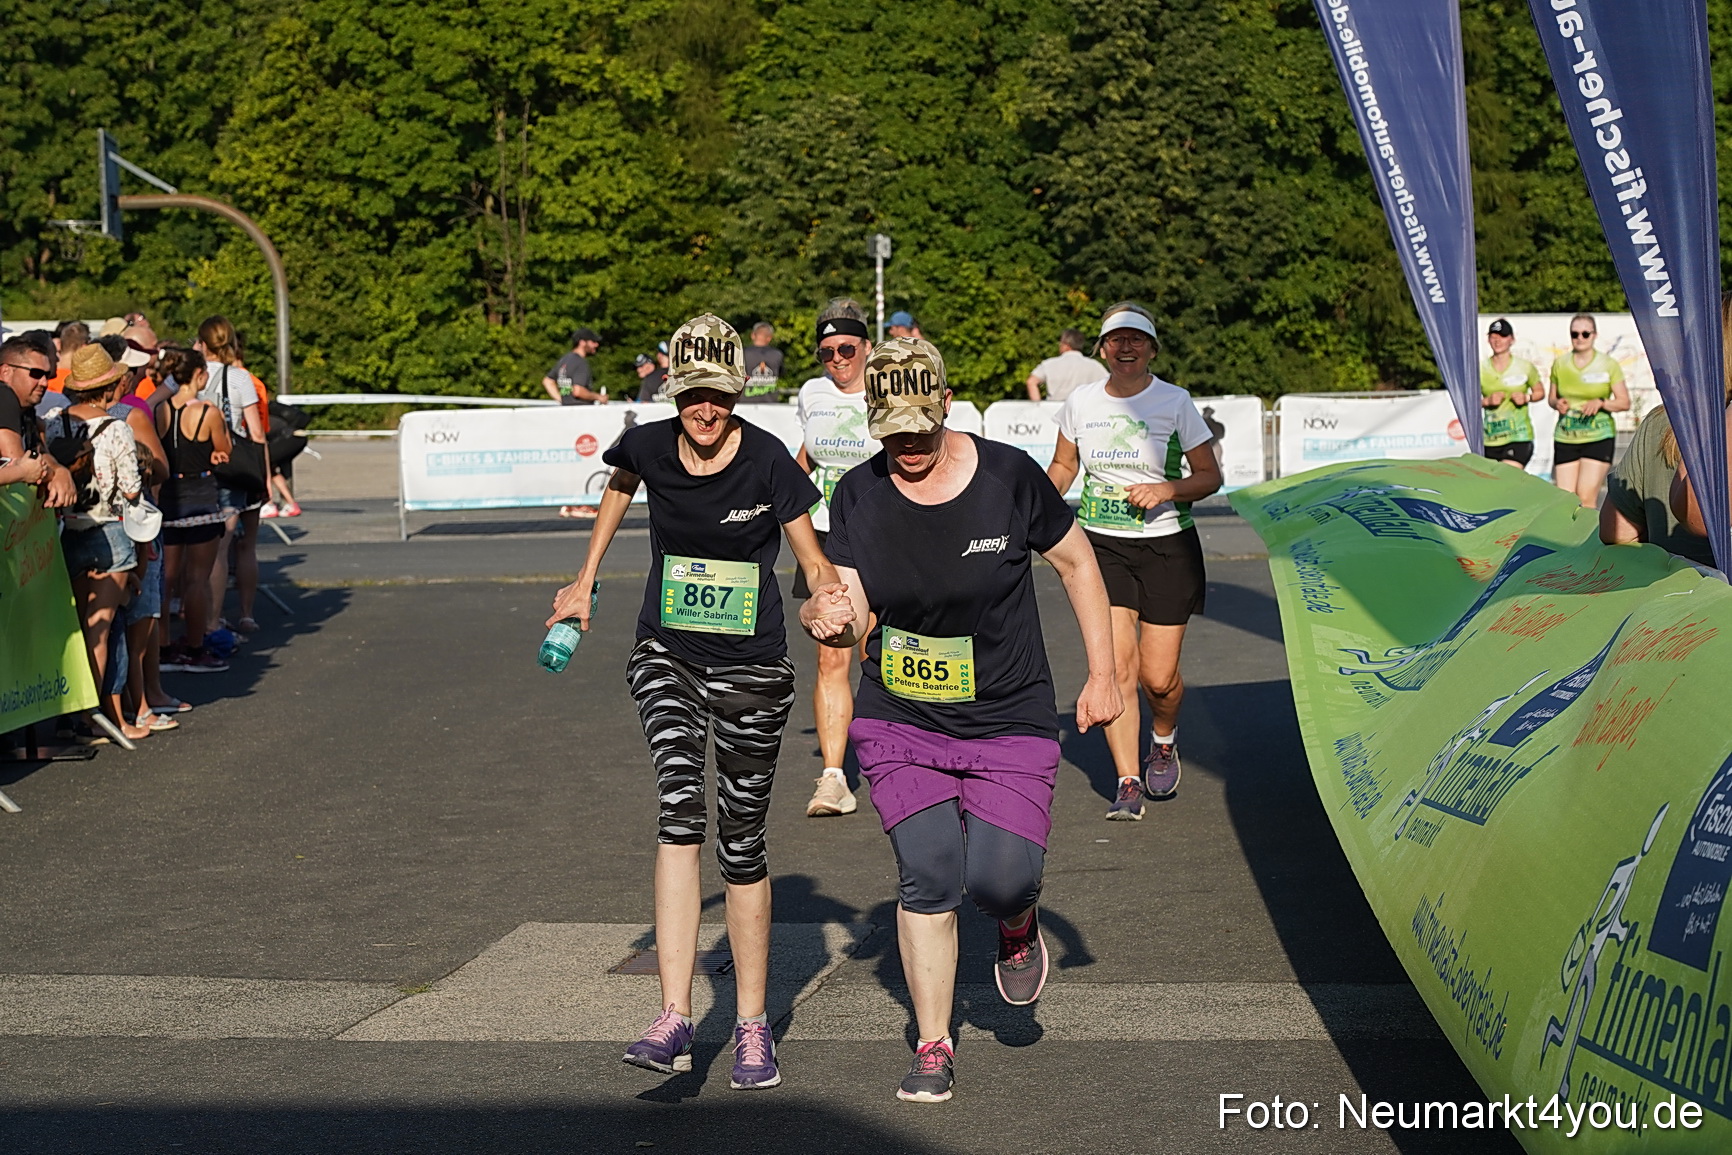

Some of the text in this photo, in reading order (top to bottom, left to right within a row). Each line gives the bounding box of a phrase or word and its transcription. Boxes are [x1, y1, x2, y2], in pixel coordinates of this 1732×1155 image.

[675, 336, 736, 367] ICONO
[870, 368, 932, 399] ICONO
[1007, 423, 1041, 435] NOW
[1304, 418, 1339, 430] NOW
[424, 431, 460, 443] NOW
[815, 436, 866, 448] Laufend
[1090, 449, 1140, 461] Laufend
[1088, 462, 1150, 473] erfolgreich
[665, 588, 675, 614] RUN
[683, 582, 734, 610] 867
[676, 607, 739, 621] Willer Sabrina
[742, 591, 754, 625] 2022
[886, 653, 894, 686] WALK
[902, 655, 949, 682] 865
[960, 663, 970, 693] 2022
[894, 676, 960, 691] Peters Beatrice
